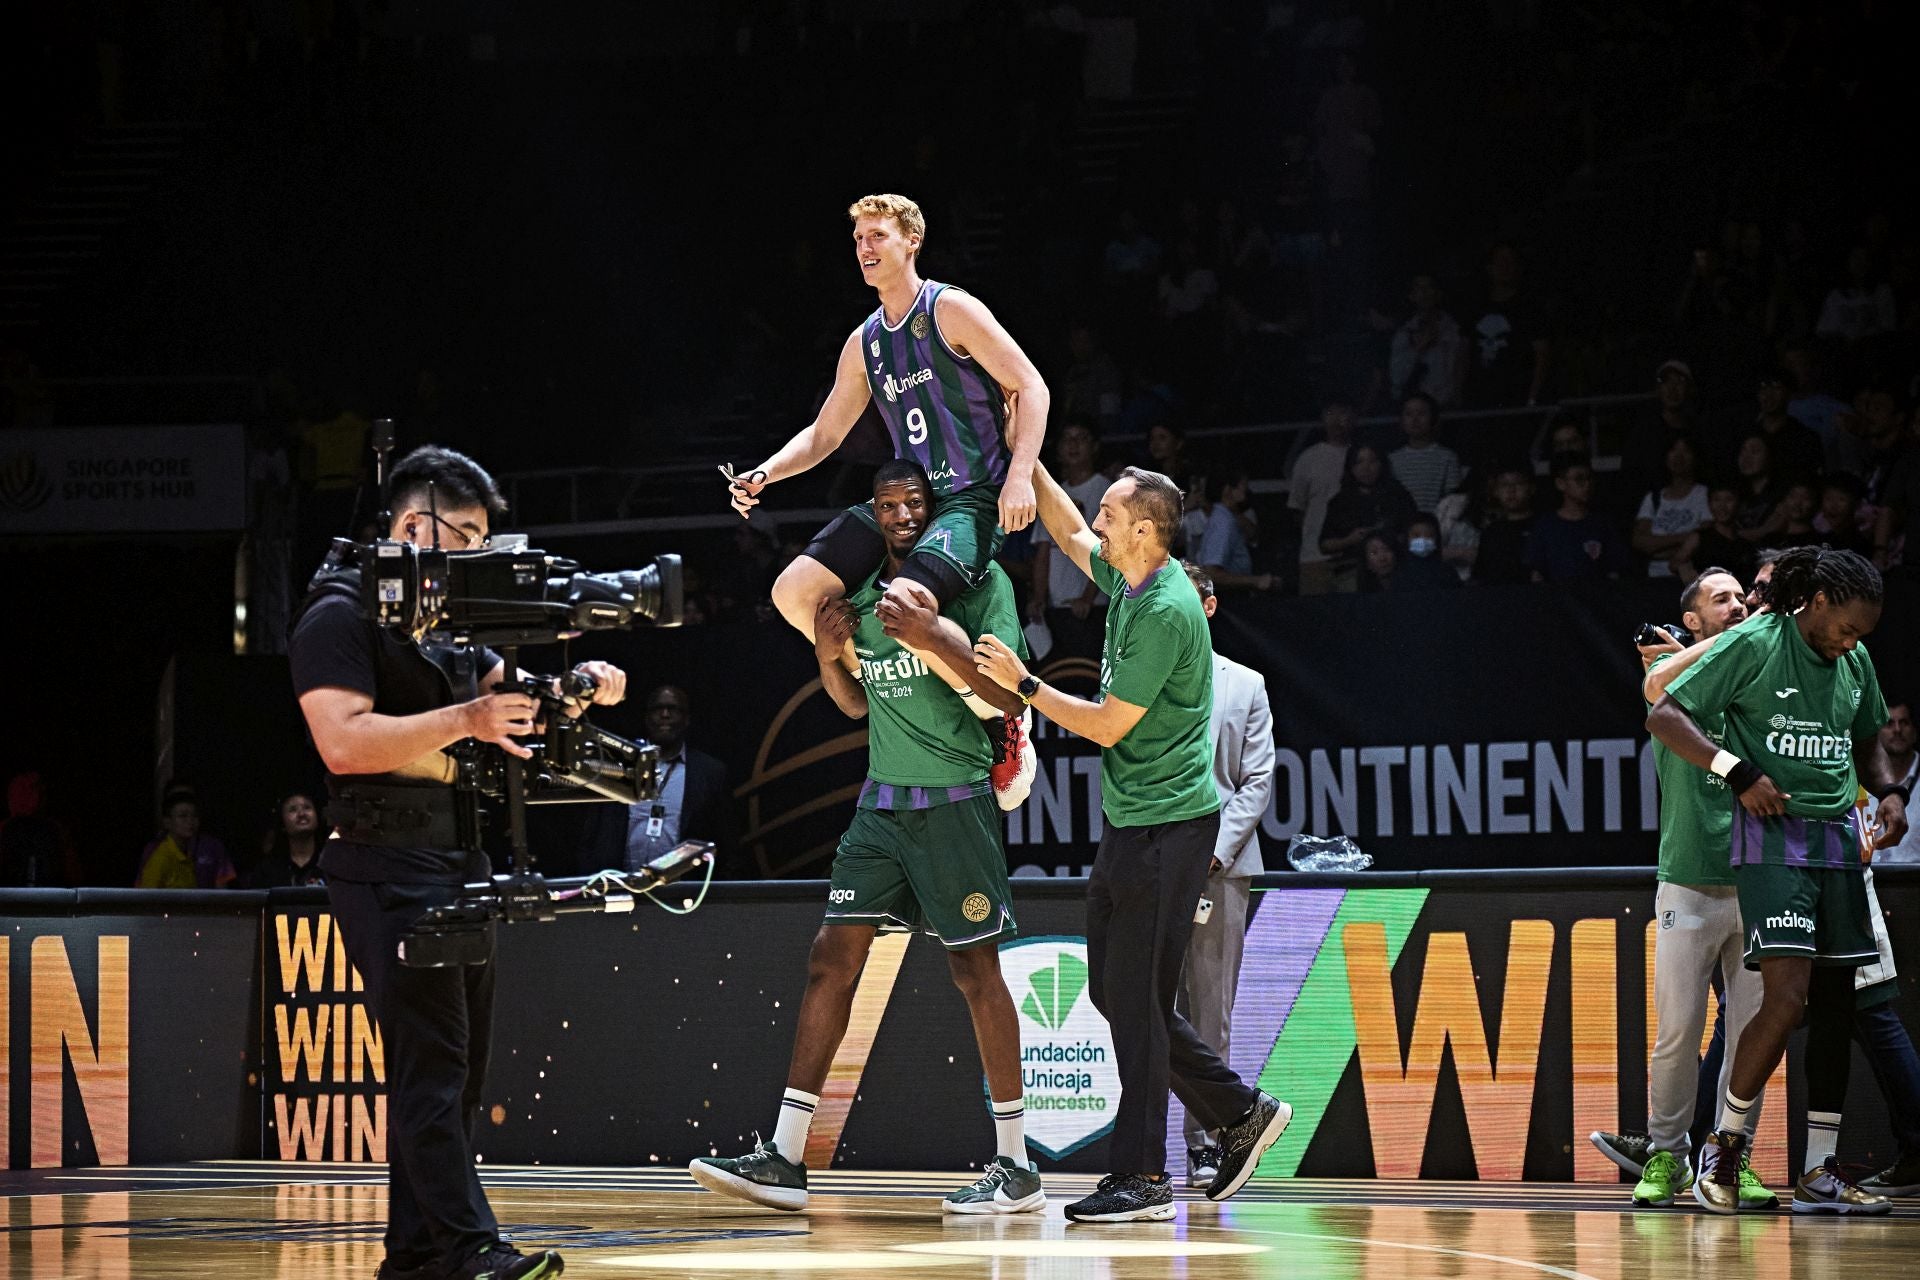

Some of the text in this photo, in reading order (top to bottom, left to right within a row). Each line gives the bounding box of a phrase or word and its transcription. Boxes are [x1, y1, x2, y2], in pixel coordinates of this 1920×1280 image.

[906, 407, 928, 445] 9
[66, 458, 191, 478] SINGAPORE
[63, 480, 196, 500] SPORTS HUB
[892, 685, 913, 698] 2024
[829, 889, 856, 904] aga
[275, 913, 364, 992] WI
[274, 1003, 387, 1084] WIN
[1020, 1040, 1105, 1062] undación
[1022, 1068, 1092, 1094] Unicaja
[1023, 1093, 1107, 1111] aloncesto
[273, 1093, 388, 1163] WIN
